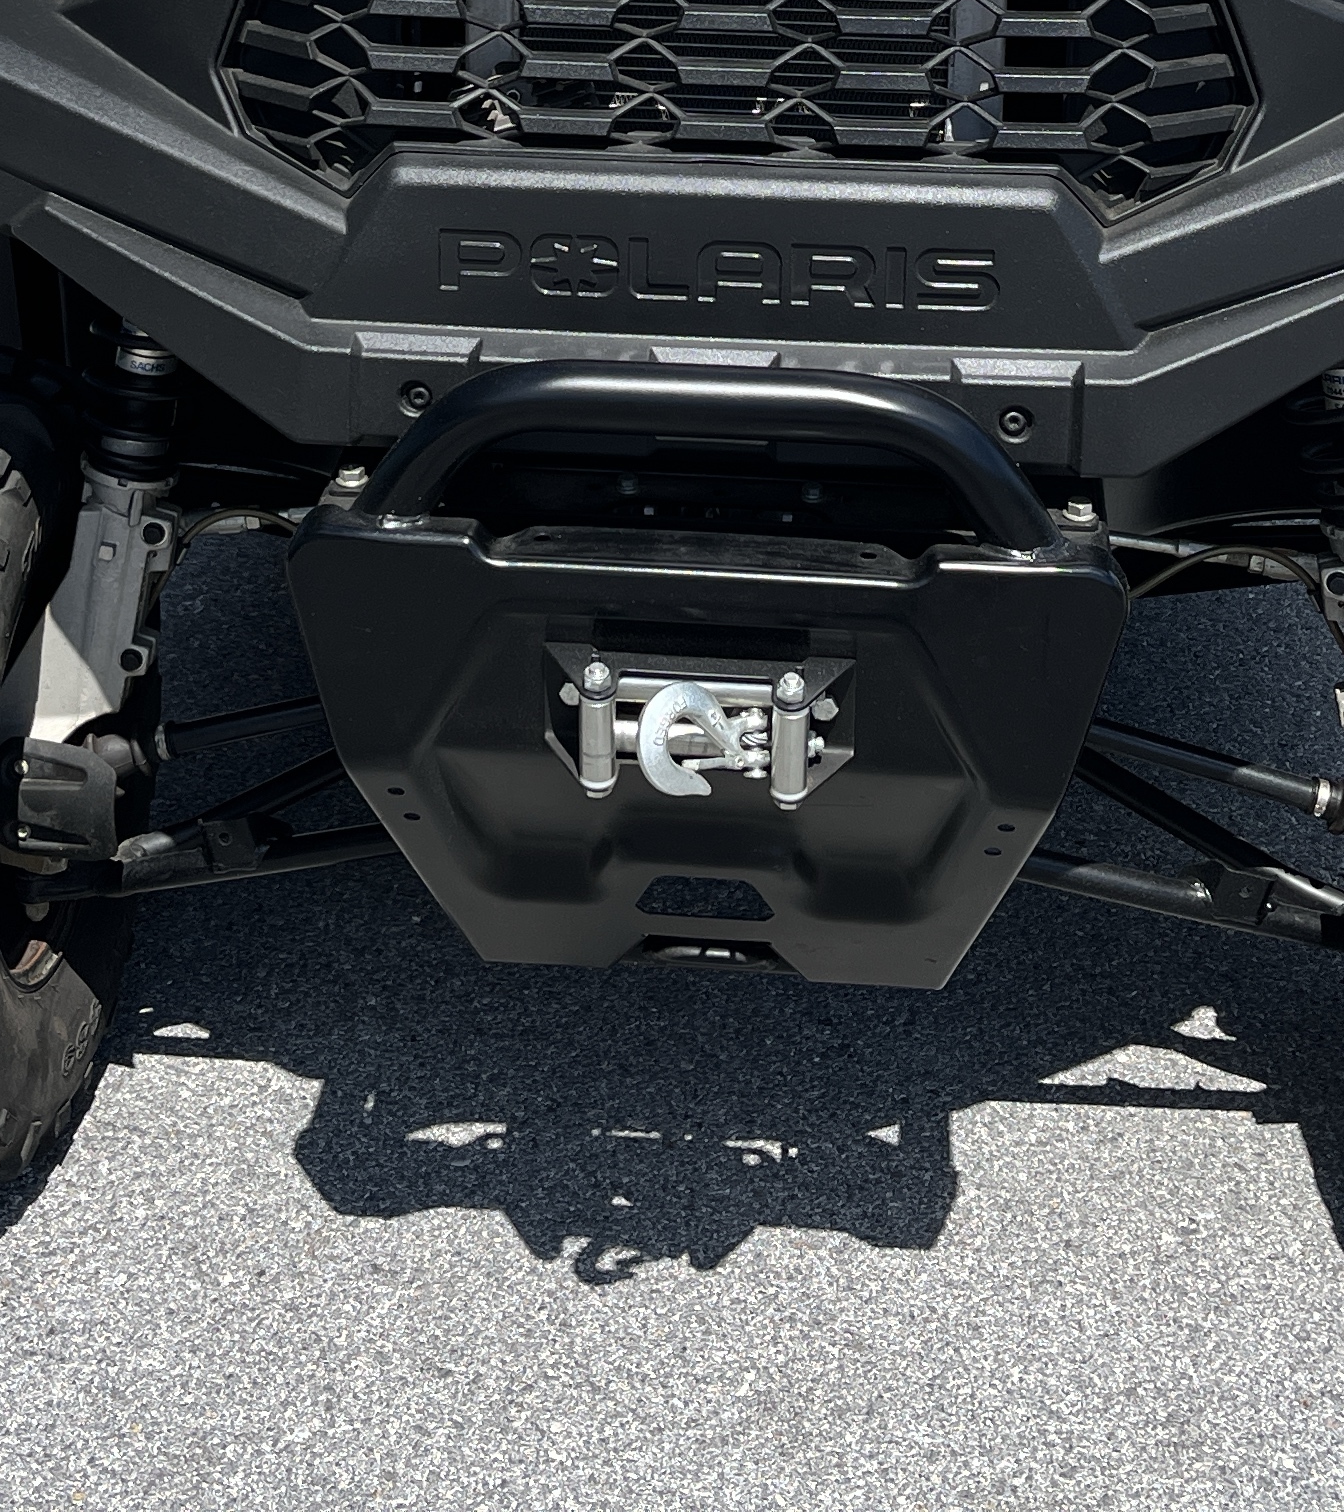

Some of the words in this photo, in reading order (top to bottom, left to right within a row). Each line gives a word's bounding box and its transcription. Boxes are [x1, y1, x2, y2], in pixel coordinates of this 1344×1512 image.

[438, 227, 1000, 311] POLARIS
[130, 360, 166, 372] SACHS
[654, 695, 688, 746] FORGED
